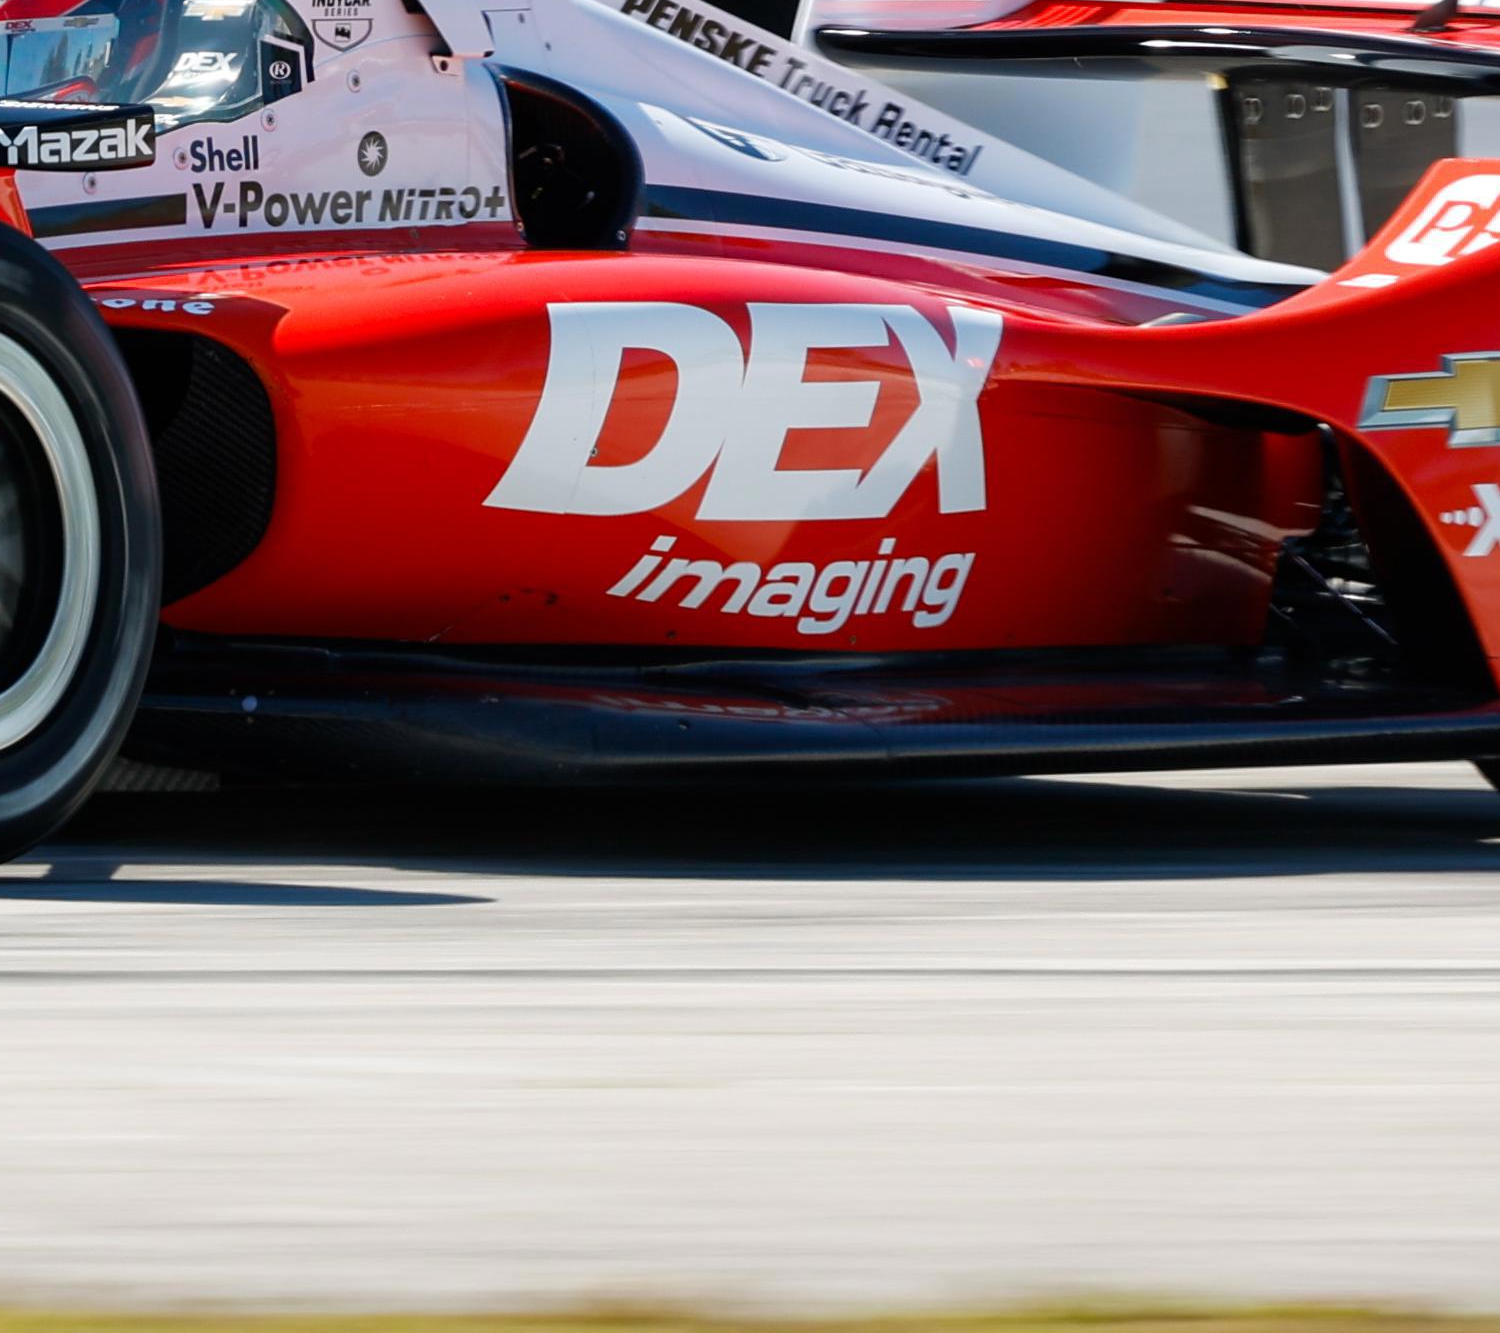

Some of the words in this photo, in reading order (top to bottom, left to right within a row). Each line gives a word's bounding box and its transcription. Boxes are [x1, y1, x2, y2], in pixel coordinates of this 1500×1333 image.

[324, 8, 359, 17] SERIES
[173, 51, 239, 73] DEX
[777, 56, 870, 124] Truck
[870, 102, 985, 177] Rental
[189, 135, 260, 173] Shell
[192, 180, 373, 229] V-Power
[480, 300, 1004, 521] DEX
[605, 535, 976, 636] imaging
